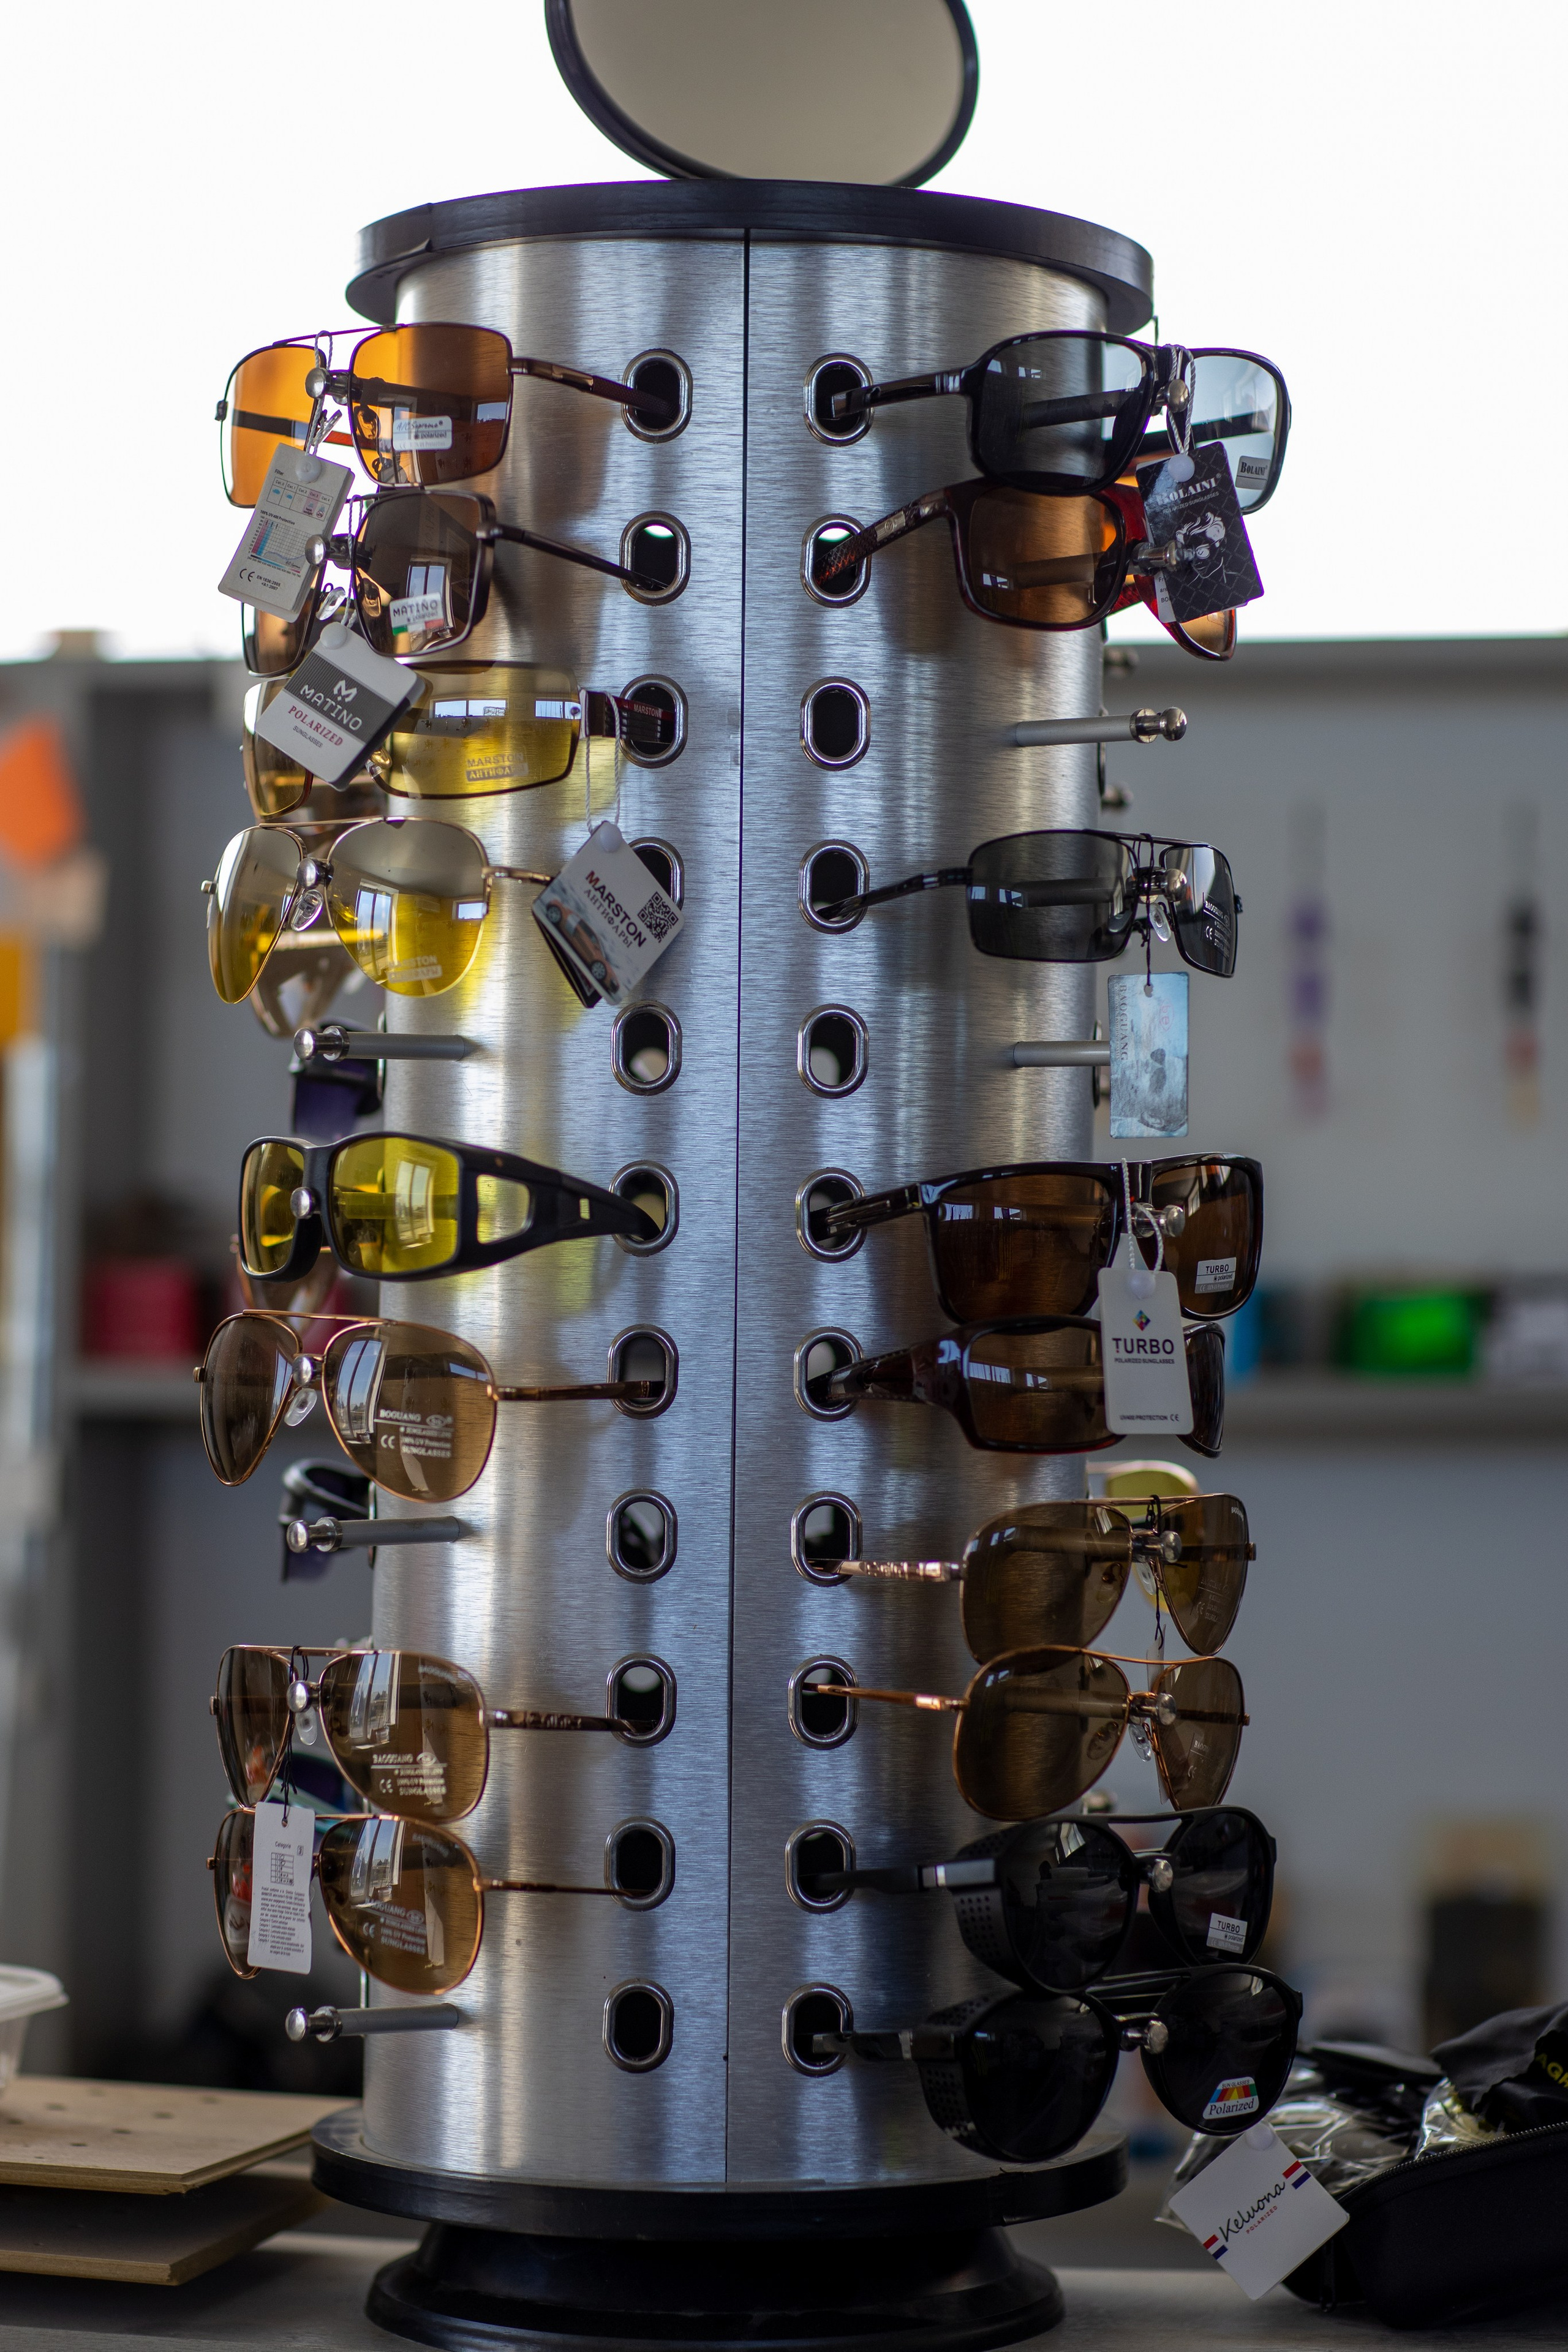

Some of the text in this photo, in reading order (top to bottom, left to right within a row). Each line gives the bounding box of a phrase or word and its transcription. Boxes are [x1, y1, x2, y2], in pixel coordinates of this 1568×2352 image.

[421, 431, 447, 439] polarized
[278, 516, 296, 526] Protection
[239, 568, 255, 582] CE
[300, 684, 363, 731] MATINO
[633, 704, 660, 718] MARSTON
[287, 705, 344, 747] POLARIZED
[292, 725, 323, 748] SUNGLASSES
[467, 753, 524, 768] MARSTON
[468, 764, 526, 780] АНТИФА
[586, 870, 647, 948] MARSTON
[584, 889, 633, 948] АНТИФАРЫ
[1119, 984, 1129, 1061] BAOGUANG
[1205, 1264, 1229, 1273] TURBO
[1217, 1273, 1233, 1282] polarized
[1112, 1338, 1175, 1355] TURBO
[1170, 1414, 1180, 1422] CE
[401, 1445, 453, 1458] SUNGLASSES
[380, 1779, 393, 1794] CE
[399, 1785, 447, 1796] SUNGLASSES
[1217, 1920, 1240, 1934] TURBO
[380, 1936, 426, 1955] SUNGLASSES
[1231, 2079, 1250, 2087] GLASSES
[1208, 2098, 1254, 2116] Polarized
[1245, 2204, 1278, 2234] POLARIZED
